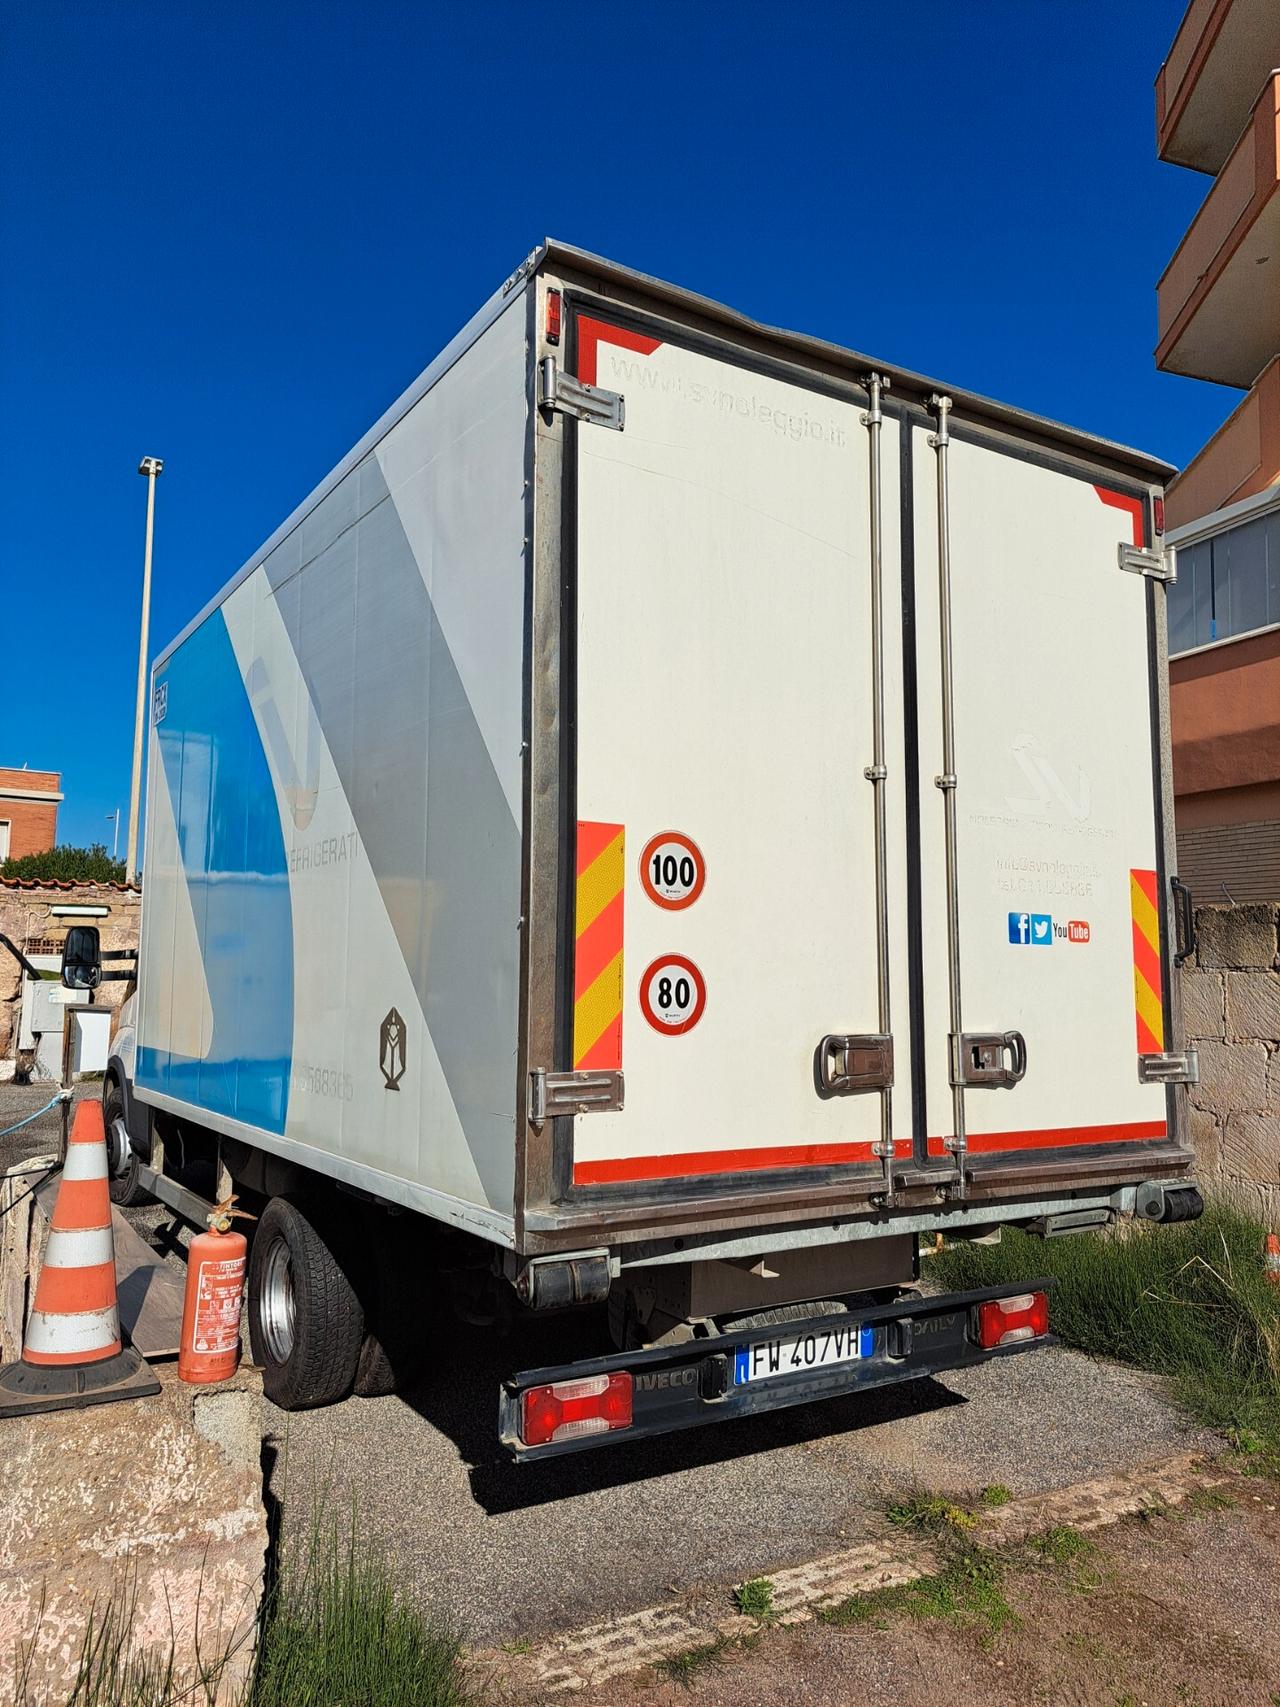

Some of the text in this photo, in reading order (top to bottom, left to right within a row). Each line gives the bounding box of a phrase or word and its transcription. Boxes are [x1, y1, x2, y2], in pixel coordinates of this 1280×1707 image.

[652, 854, 694, 887] 100
[658, 977, 690, 1009] 80
[914, 1315, 956, 1337] DAILY
[753, 1341, 780, 1376] FW
[790, 1326, 859, 1367] 407VH
[635, 1368, 696, 1392] IVECO
